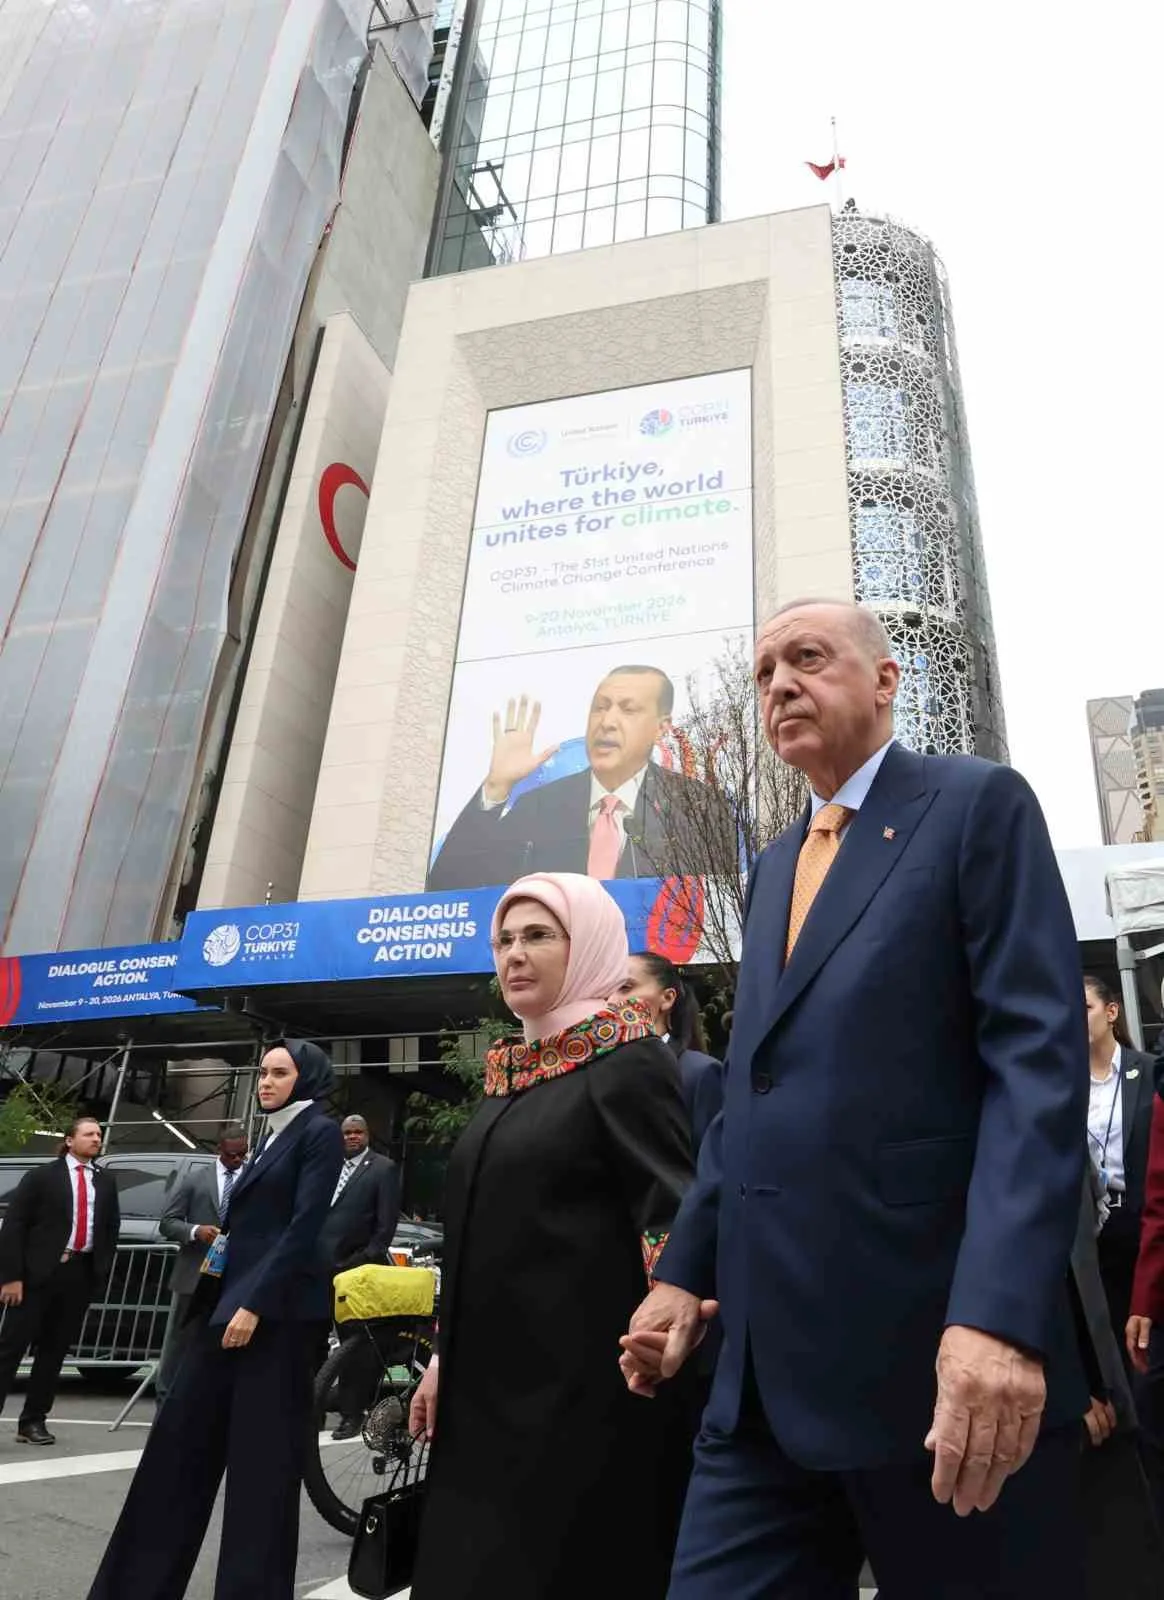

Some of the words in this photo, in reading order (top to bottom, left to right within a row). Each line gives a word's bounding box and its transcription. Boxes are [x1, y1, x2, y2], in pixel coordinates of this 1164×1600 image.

[560, 461, 665, 488] Türkiye,
[501, 498, 585, 520] where
[592, 488, 636, 507] the
[643, 470, 723, 499] world
[486, 522, 568, 547] unites
[575, 514, 615, 534] for
[621, 498, 740, 527] climate.
[551, 560, 579, 575] The
[615, 548, 664, 564] United
[669, 540, 729, 557] Nations
[500, 578, 559, 593] Climate
[562, 569, 622, 586] Change
[626, 556, 716, 577] Conference
[563, 601, 642, 620] November
[368, 902, 470, 924] DIALOGUE
[245, 922, 300, 940] COP31
[356, 920, 477, 944] CONSENSUS
[374, 942, 452, 962] ACTION
[93, 971, 149, 988] ACTION.
[38, 998, 77, 1009] November
[101, 995, 122, 1005] 2026
